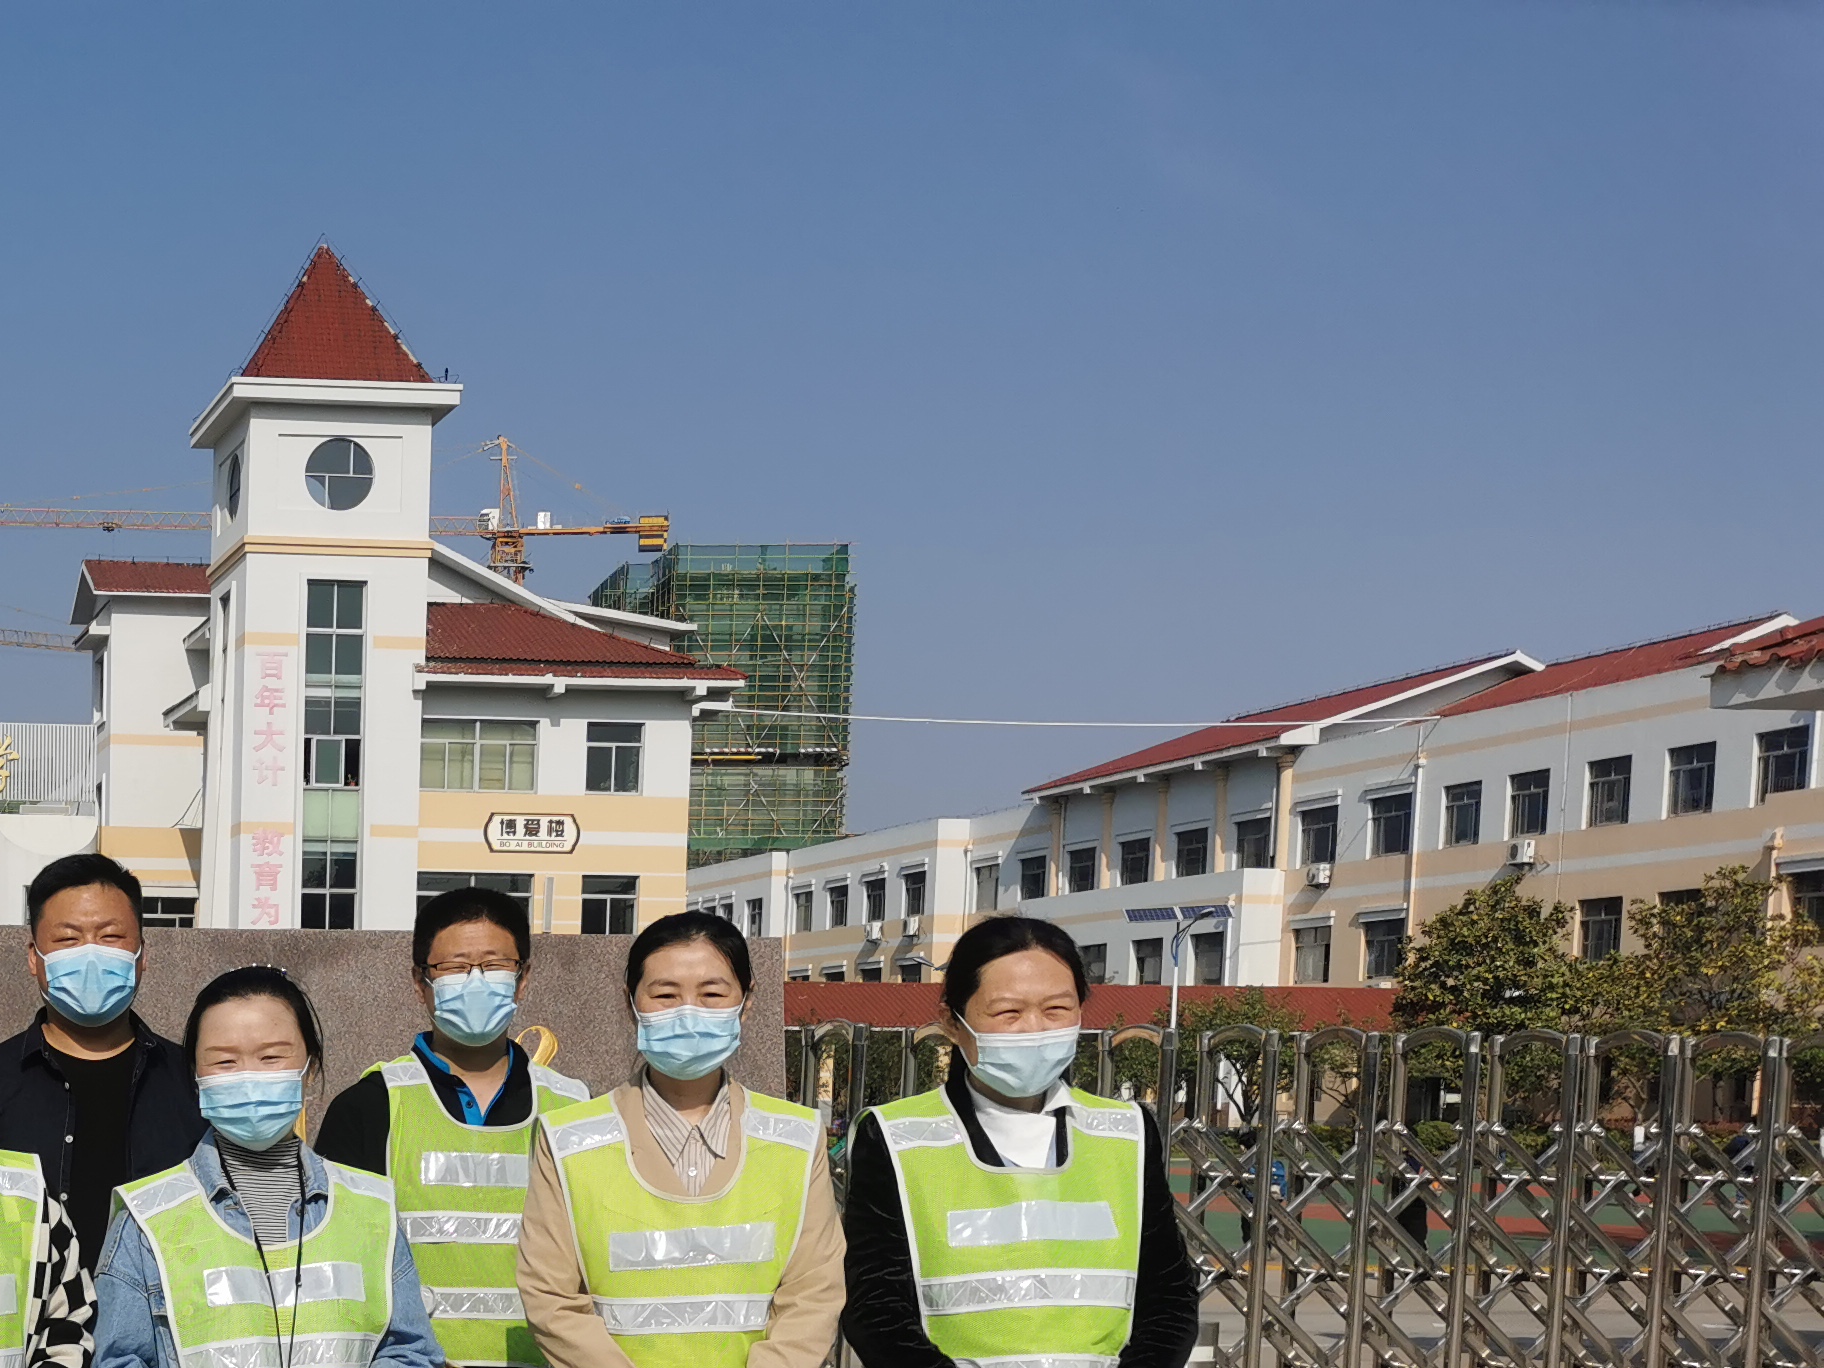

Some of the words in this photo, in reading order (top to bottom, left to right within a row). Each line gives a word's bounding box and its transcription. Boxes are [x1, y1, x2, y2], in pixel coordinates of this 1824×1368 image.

[252, 651, 289, 787] 百年大计
[499, 817, 565, 838] 博爱楼
[499, 840, 511, 848] BO
[527, 841, 565, 849] BUILDING
[250, 827, 285, 926] 教育为
